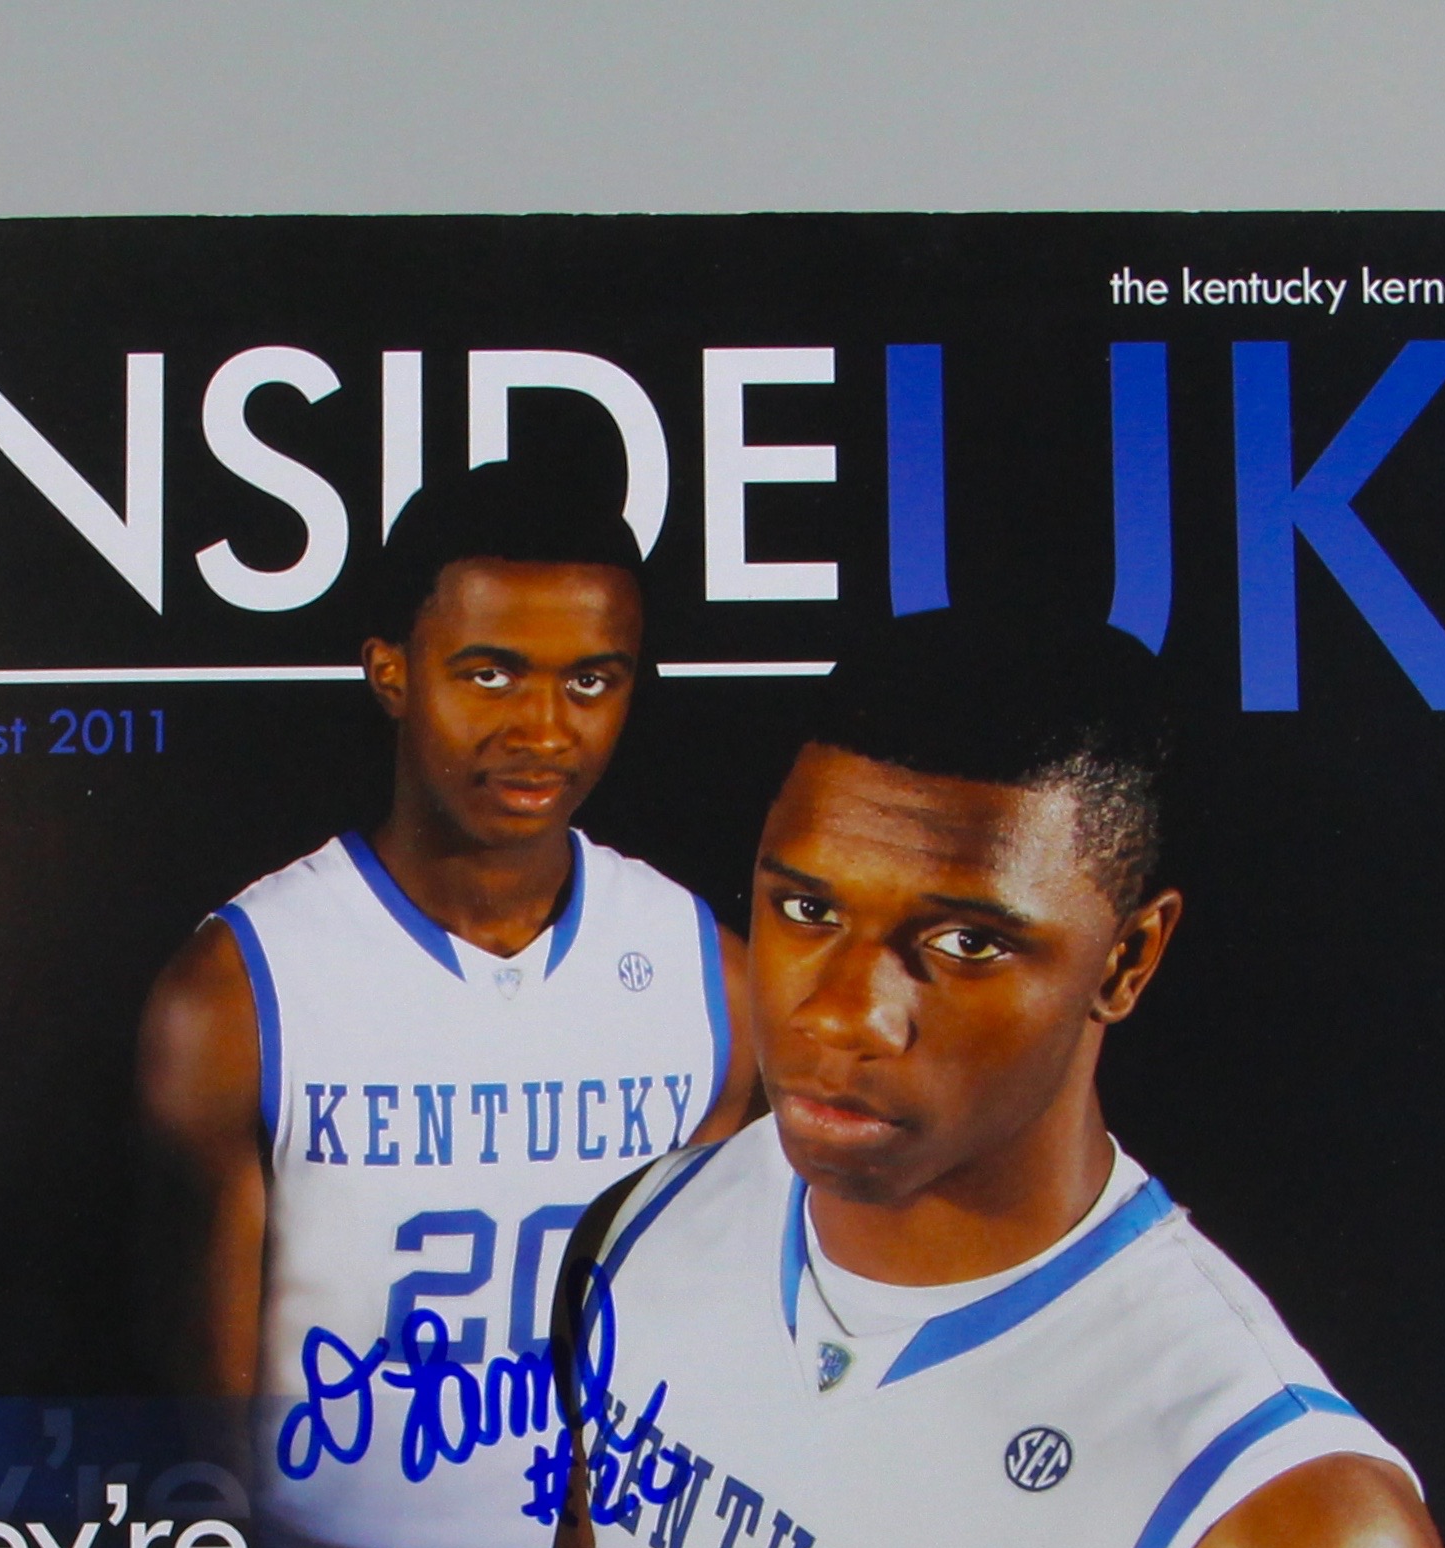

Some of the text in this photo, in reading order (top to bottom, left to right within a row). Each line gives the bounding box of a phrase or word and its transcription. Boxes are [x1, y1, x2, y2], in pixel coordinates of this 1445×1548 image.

[1110, 267, 1169, 305] the
[1182, 266, 1348, 315] kentucky
[49, 709, 167, 756] 2011
[305, 1073, 693, 1167] KENTUCKY
[1008, 1430, 1068, 1489] SEC
